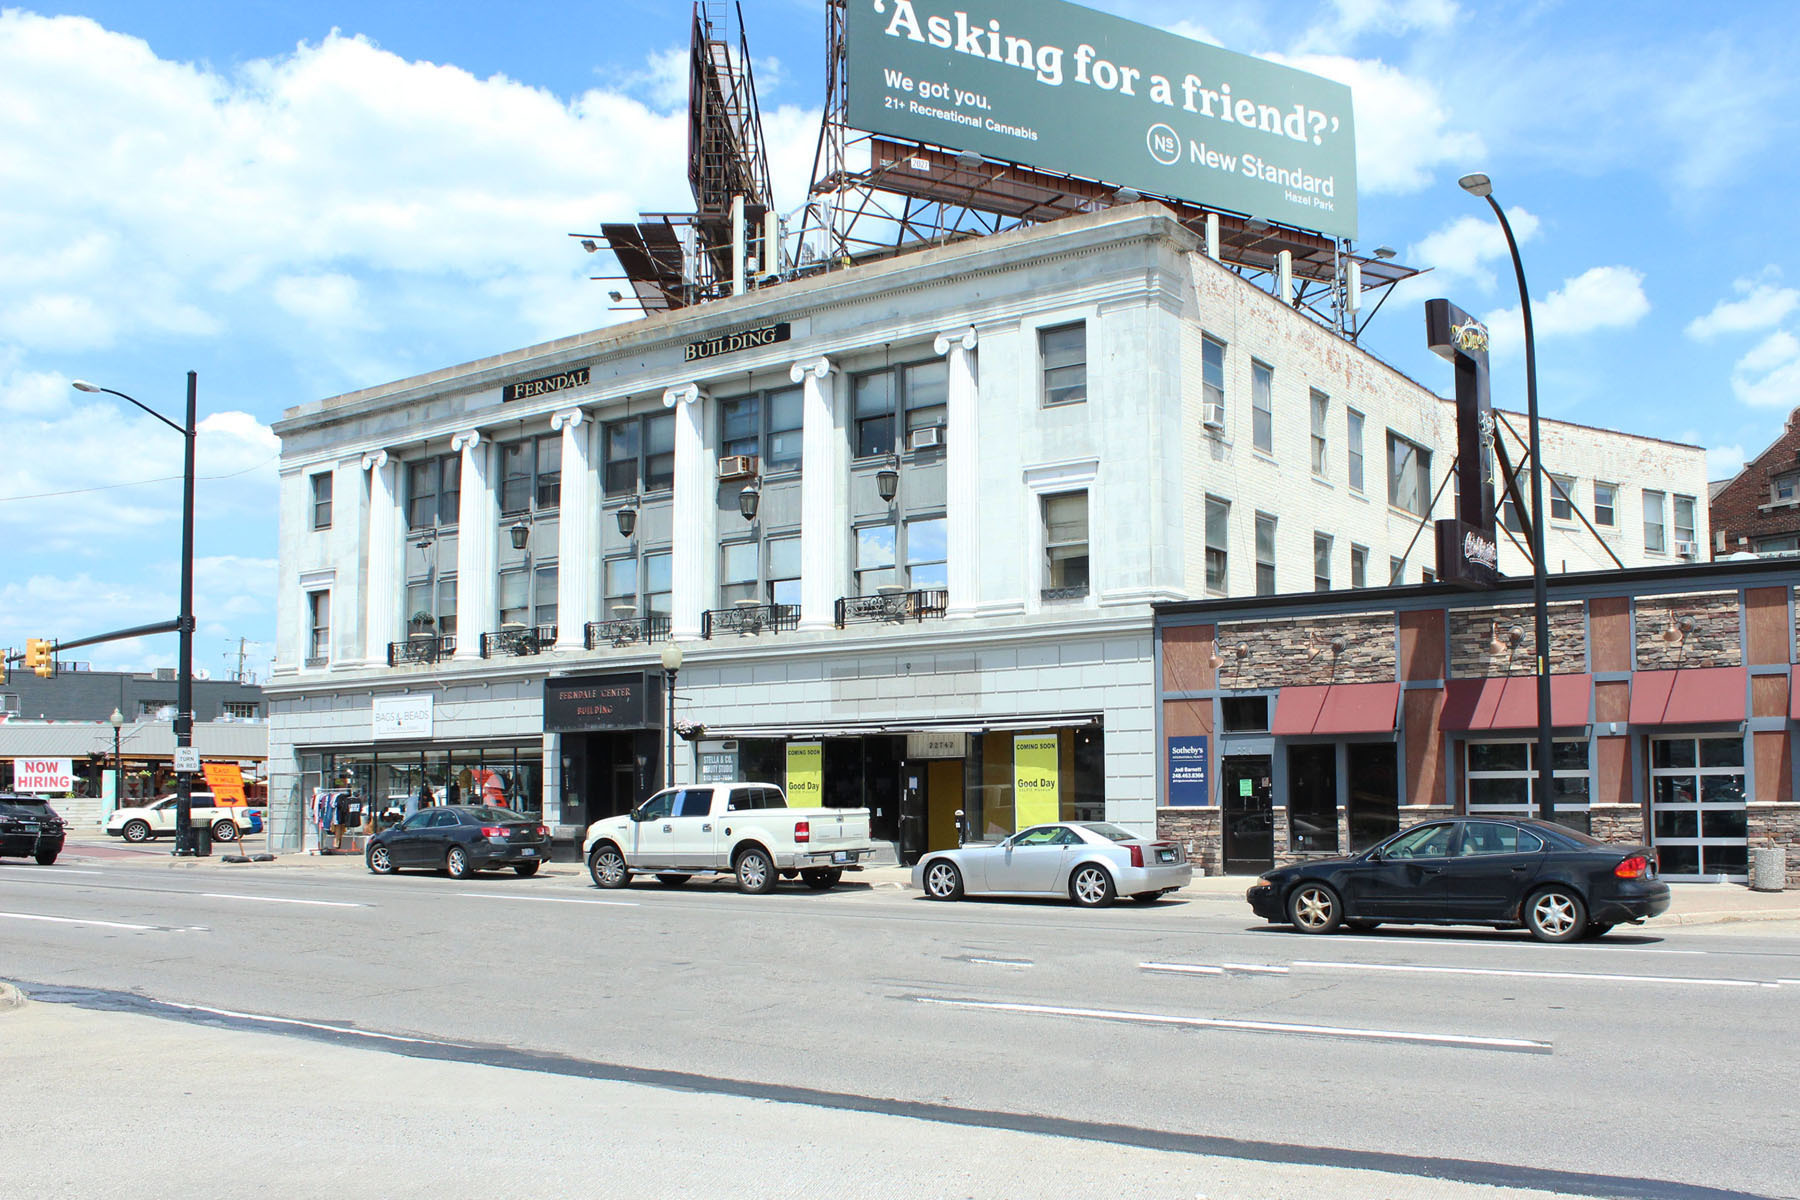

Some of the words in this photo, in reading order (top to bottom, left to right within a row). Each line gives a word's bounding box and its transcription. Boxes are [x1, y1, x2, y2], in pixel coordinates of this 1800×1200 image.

[873, 0, 1063, 86] 'Asking
[1073, 43, 1141, 97] for
[1149, 74, 1175, 107] a
[1181, 73, 1339, 146] friend?'
[884, 68, 914, 91] We
[919, 80, 950, 100] got
[954, 88, 991, 110] you.
[884, 95, 905, 110] 21+
[909, 100, 982, 129] Recreational
[985, 118, 1038, 141] Cannabis
[1189, 140, 1237, 173] New
[1241, 153, 1335, 198] Standard
[1284, 190, 1311, 206] Hazel
[1313, 195, 1335, 212] Park
[685, 328, 777, 361] BUILDING
[513, 370, 590, 399] FERNDAL
[559, 689, 597, 700] FERNDALE
[601, 687, 631, 697] CENTER
[375, 712, 395, 722] BAGS
[404, 710, 429, 720] BEADS
[577, 705, 613, 715] BUILDING
[1172, 746, 1204, 755] Sotheby's
[703, 755, 719, 764] STELLA
[25, 761, 59, 773] NOW
[18, 776, 70, 787] HIRING
[789, 782, 805, 790] Good
[807, 781, 820, 791] Day
[1018, 779, 1038, 788] Good
[1040, 778, 1055, 789] Day
